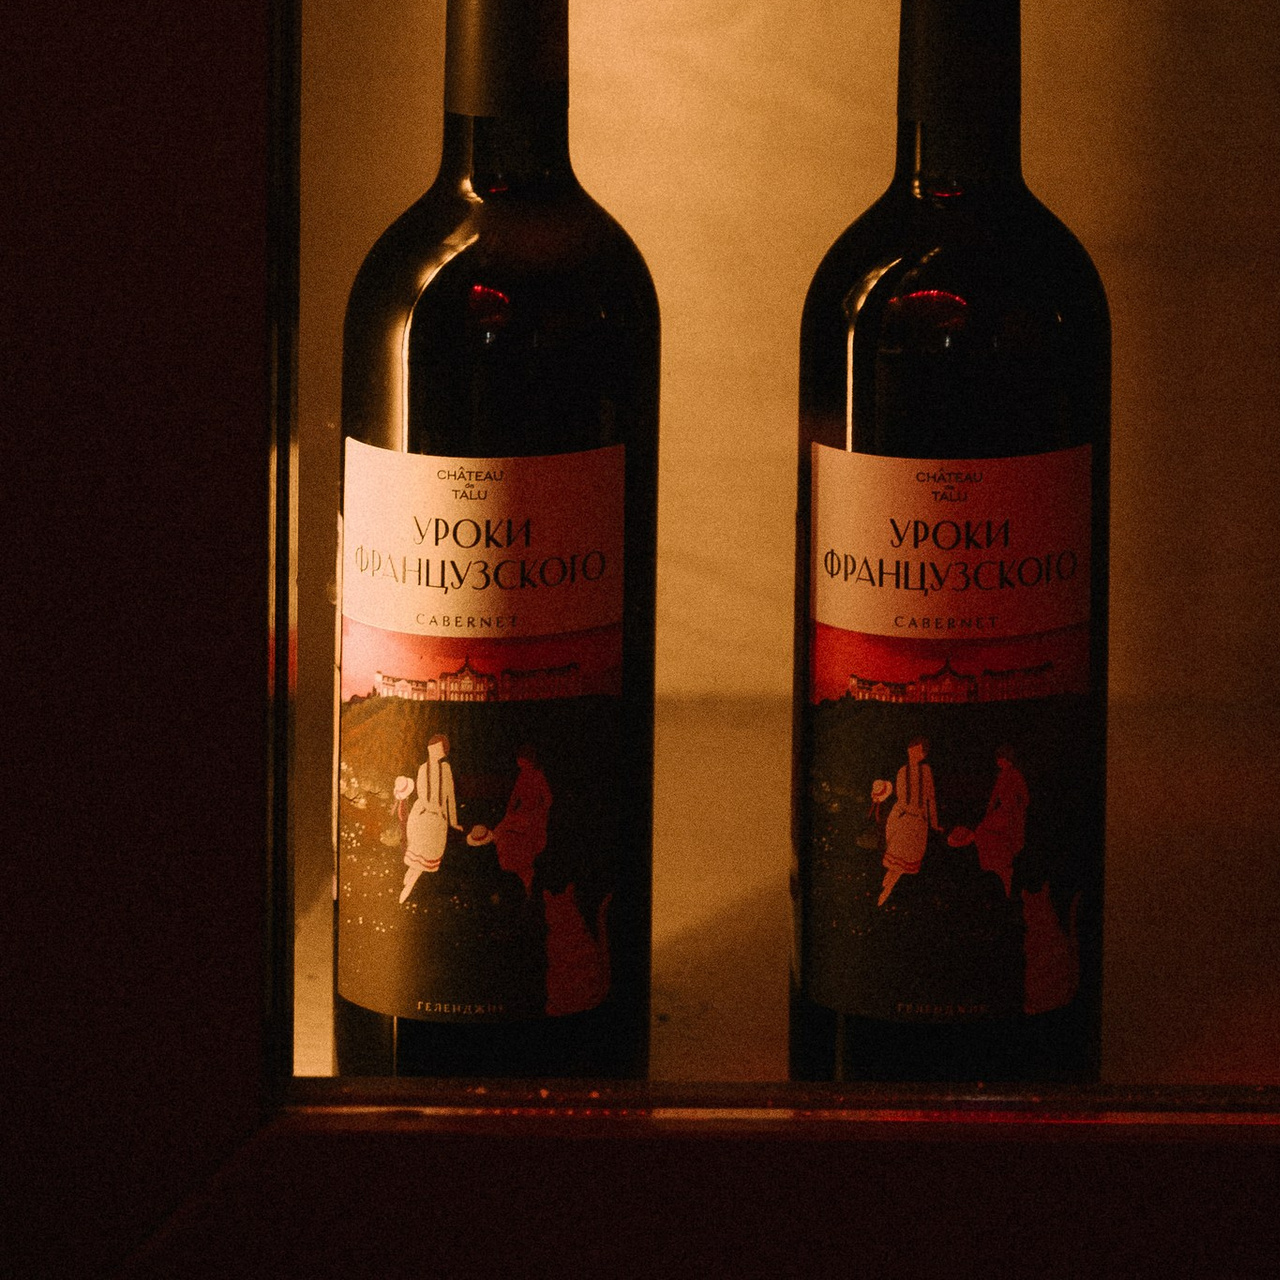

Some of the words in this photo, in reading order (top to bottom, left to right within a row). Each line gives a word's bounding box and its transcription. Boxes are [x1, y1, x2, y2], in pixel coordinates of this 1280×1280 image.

[436, 466, 505, 482] CHÂTEAU
[915, 467, 984, 483] CHÂTEAU
[451, 489, 488, 501] TALU
[931, 490, 968, 502] TALU
[413, 515, 532, 549] УРОКИ
[889, 517, 1010, 551] УРОКИ
[354, 544, 607, 594] ФРАНЦУЗСКОГО
[823, 548, 1079, 597] ФРАНЦУЗСКОГО
[415, 612, 518, 628] CABERNET
[893, 615, 999, 629] CABERNET
